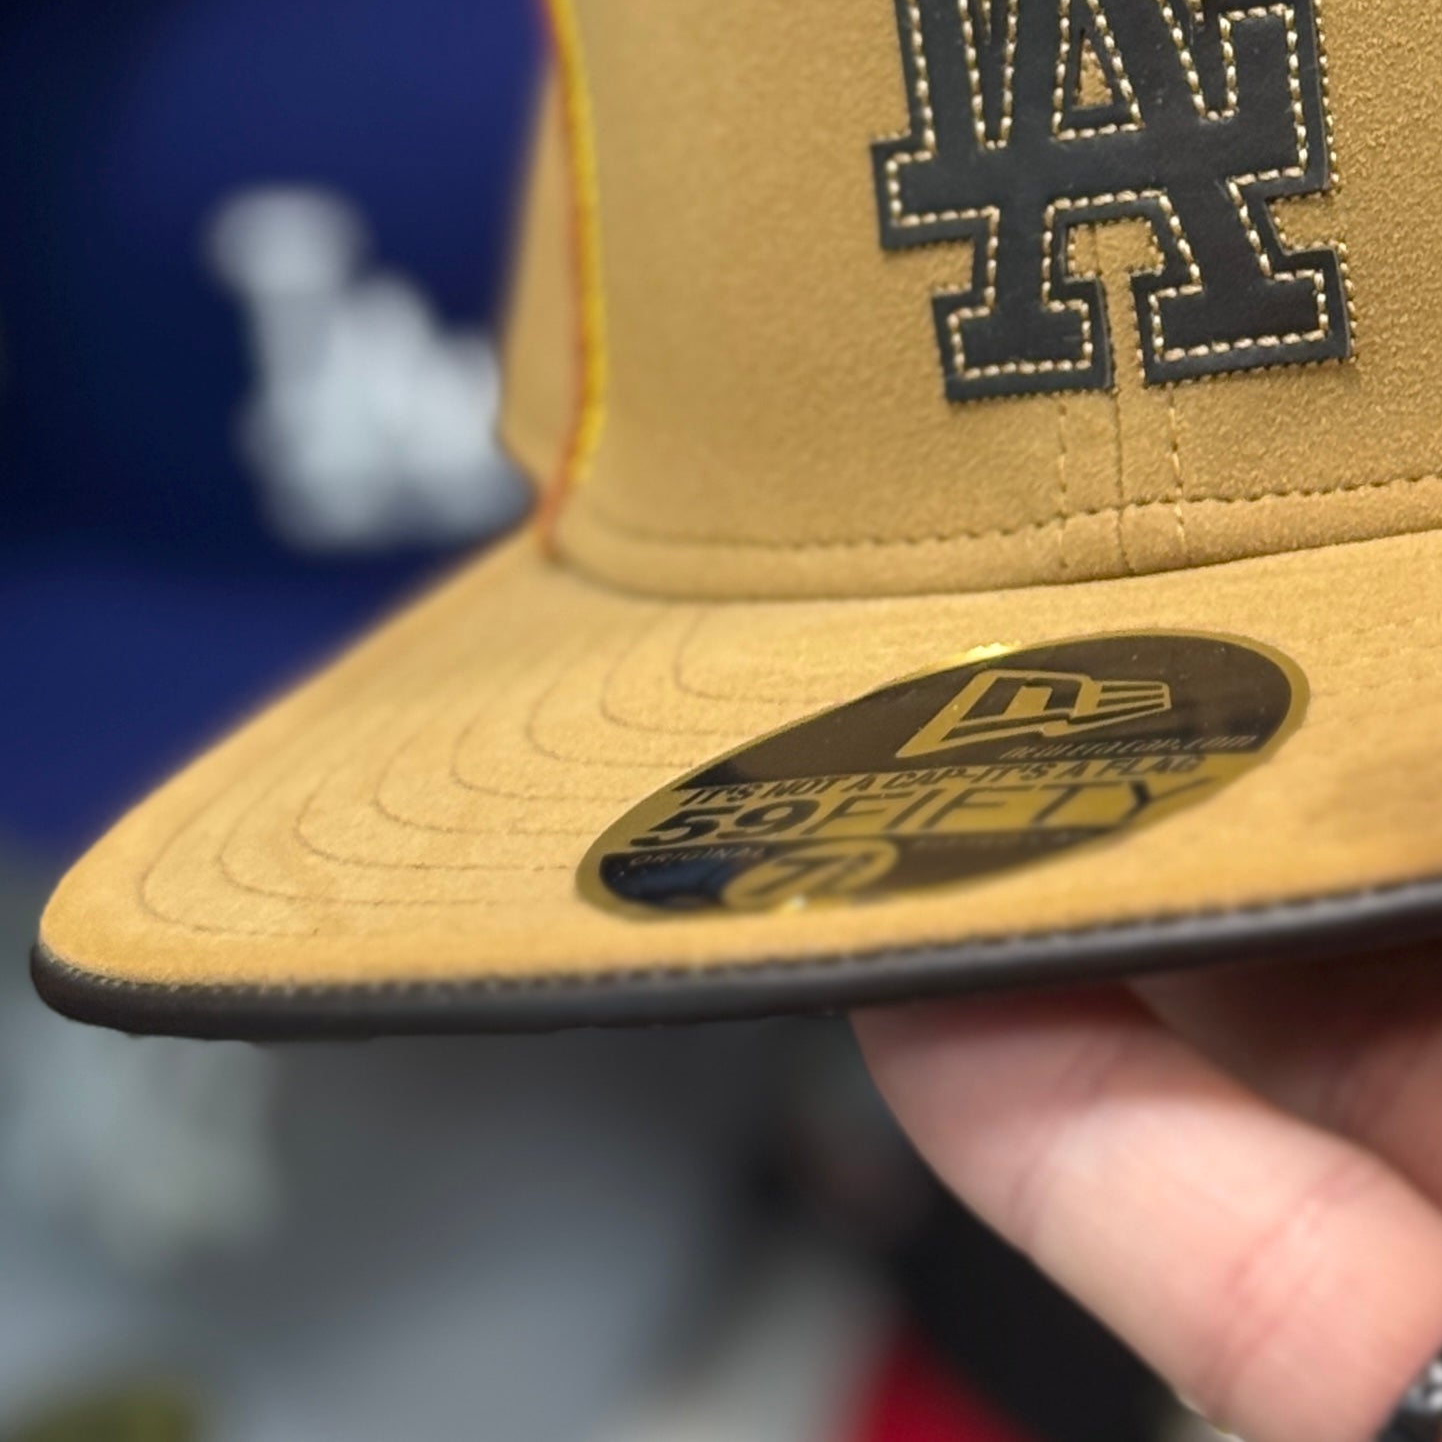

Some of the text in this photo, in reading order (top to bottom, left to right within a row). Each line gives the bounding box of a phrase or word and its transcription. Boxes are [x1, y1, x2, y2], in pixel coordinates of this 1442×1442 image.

[629, 776, 1217, 848] 59FIFTY
[679, 784, 764, 807] IT'S
[759, 776, 840, 800] NOT
[840, 773, 877, 793] A
[1055, 760, 1090, 781] A
[1092, 755, 1206, 778] FLAG
